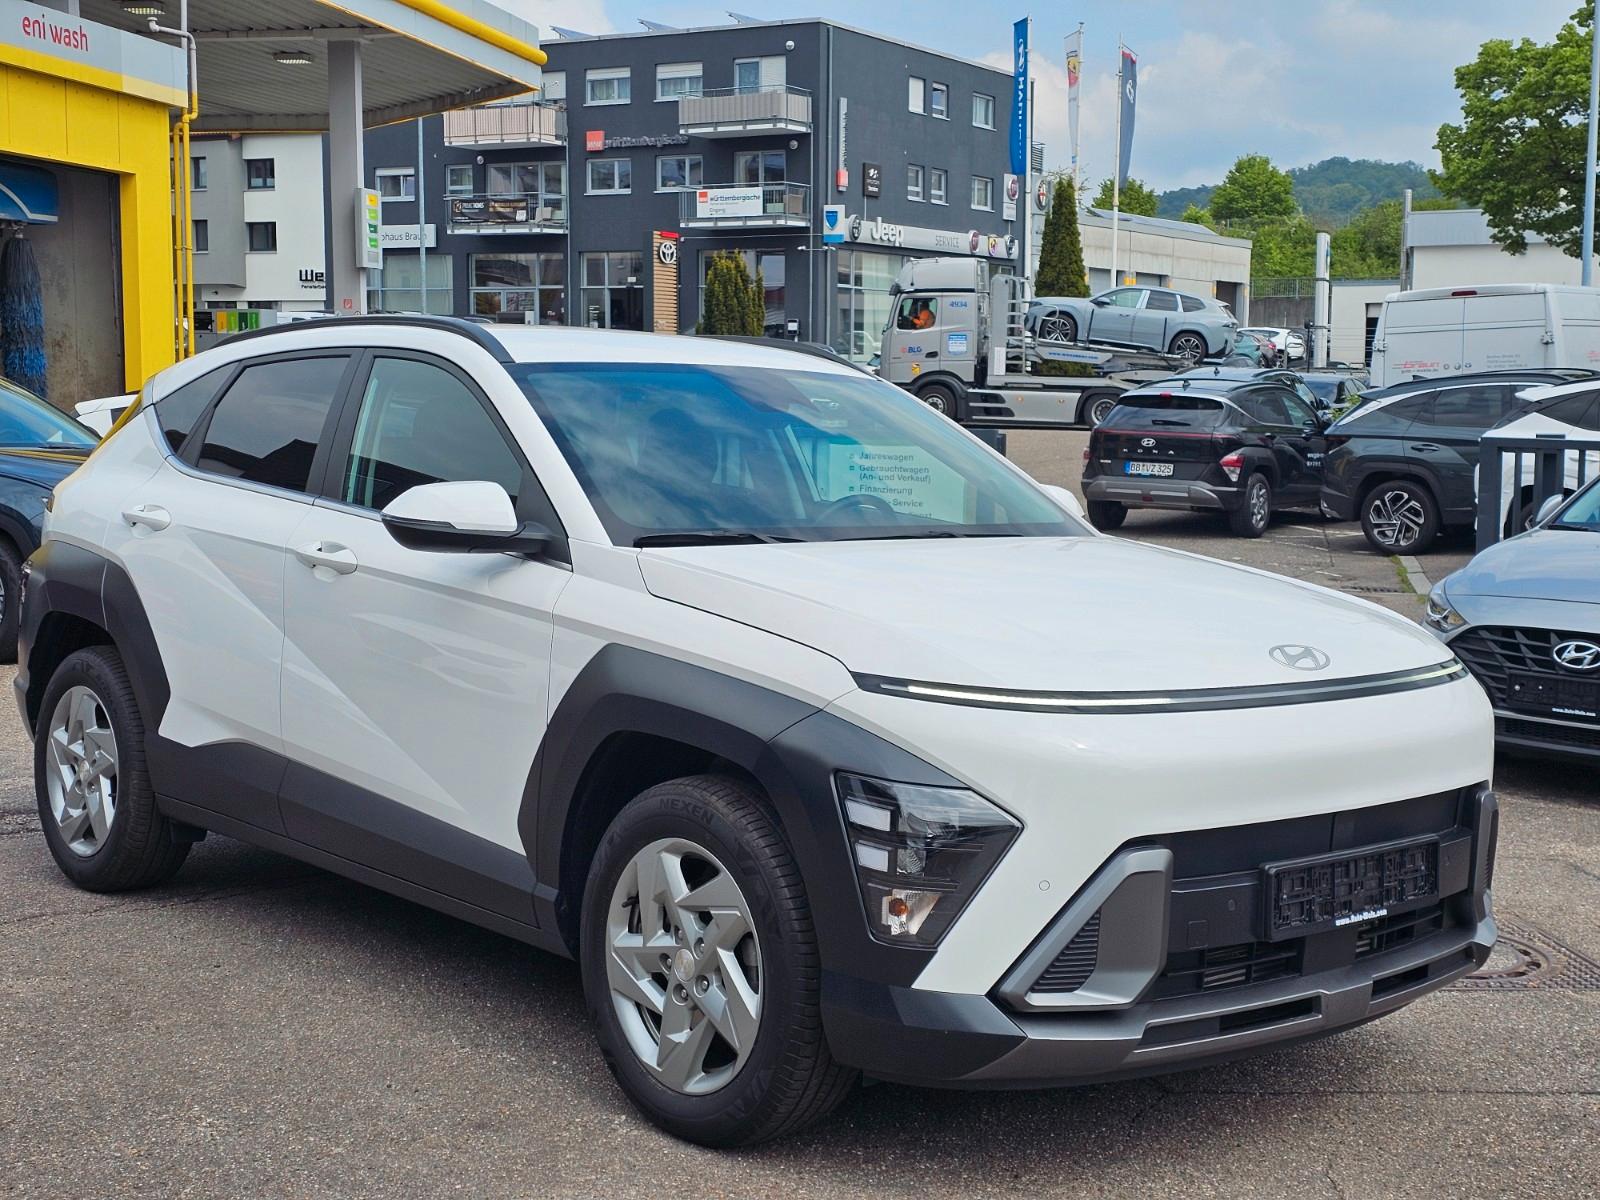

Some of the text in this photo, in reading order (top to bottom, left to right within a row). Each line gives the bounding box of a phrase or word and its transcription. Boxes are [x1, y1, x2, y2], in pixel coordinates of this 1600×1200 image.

[22, 13, 89, 52] eni wash
[871, 216, 960, 249] Jeep SERVICE
[907, 346, 922, 354] BLG
[859, 452, 914, 462] Jahreswagen
[859, 465, 929, 475] Gebrauchtwagen
[1146, 464, 1156, 473] VZ
[1157, 465, 1172, 474] 325
[860, 473, 877, 481] (An-
[897, 474, 932, 484] Verkauf)
[859, 484, 913, 495] Finanzierung
[658, 798, 715, 825] NEXEN
